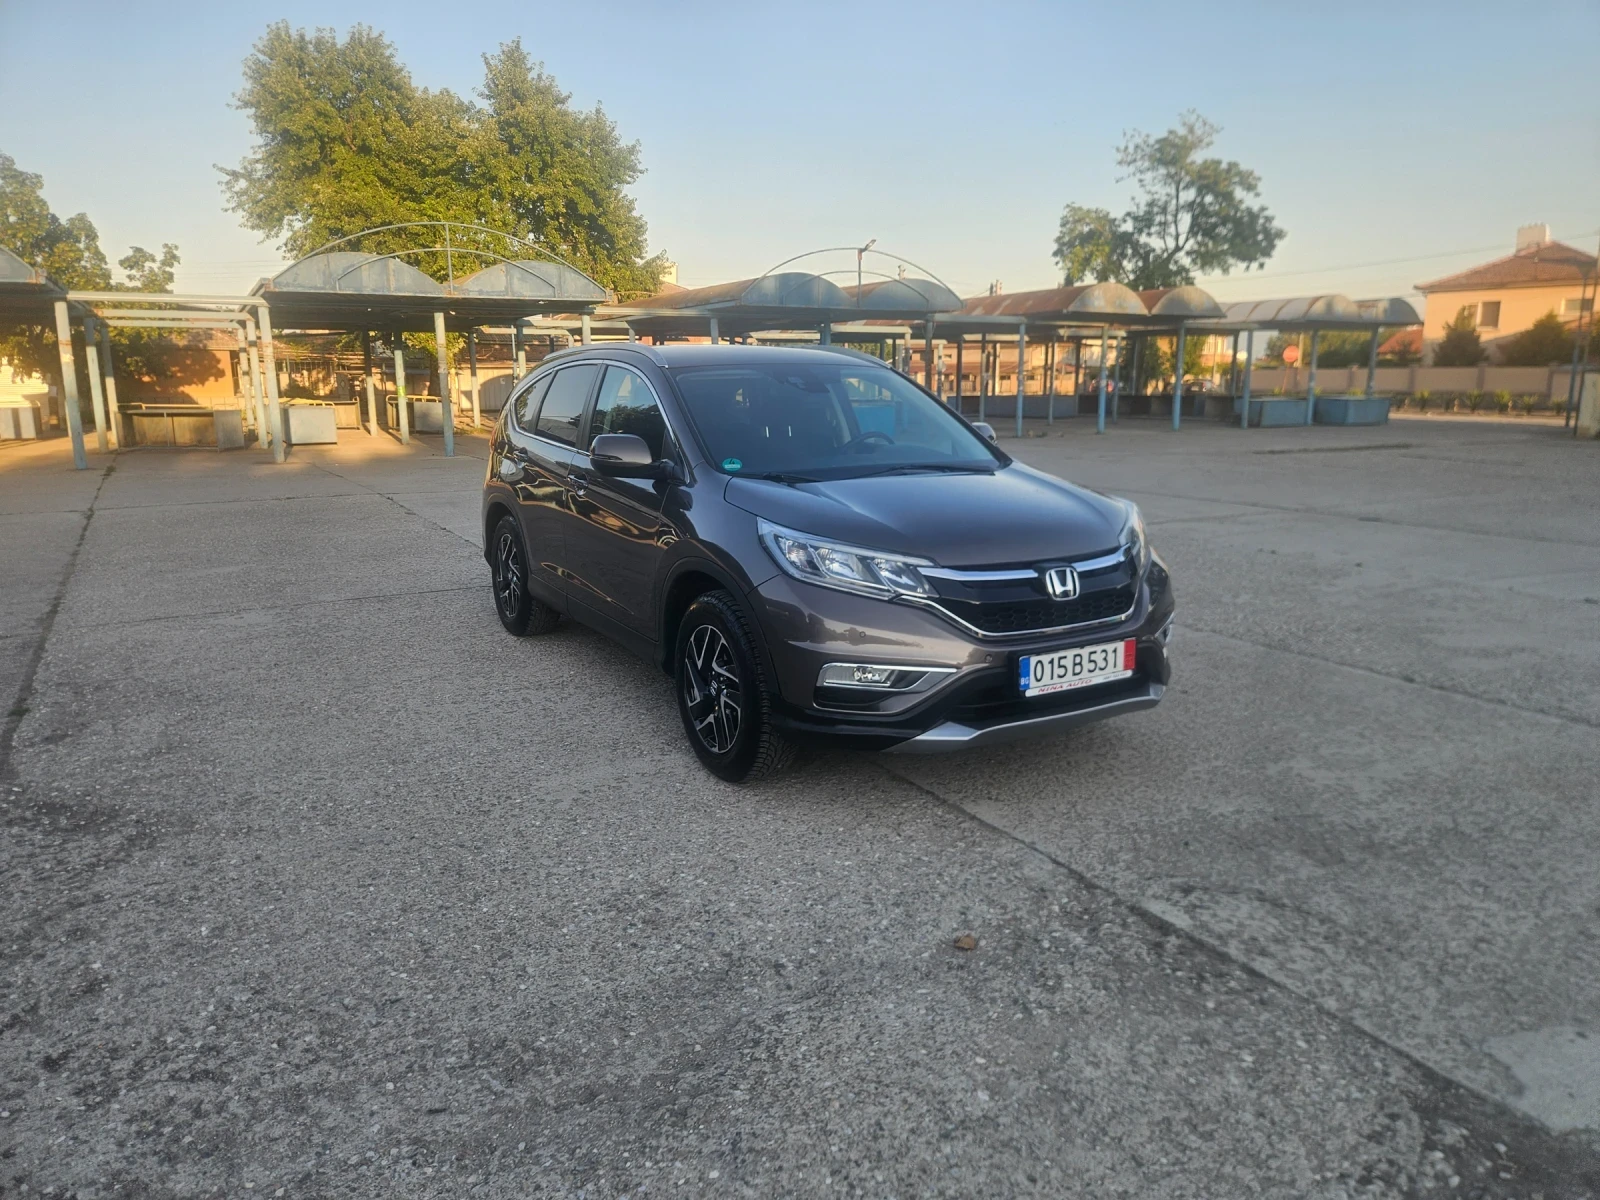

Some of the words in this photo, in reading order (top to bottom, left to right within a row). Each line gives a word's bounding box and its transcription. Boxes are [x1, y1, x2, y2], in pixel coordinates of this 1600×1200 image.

[1020, 676, 1030, 685] BG
[1038, 682, 1064, 693] NINA
[1066, 679, 1093, 688] AUTO
